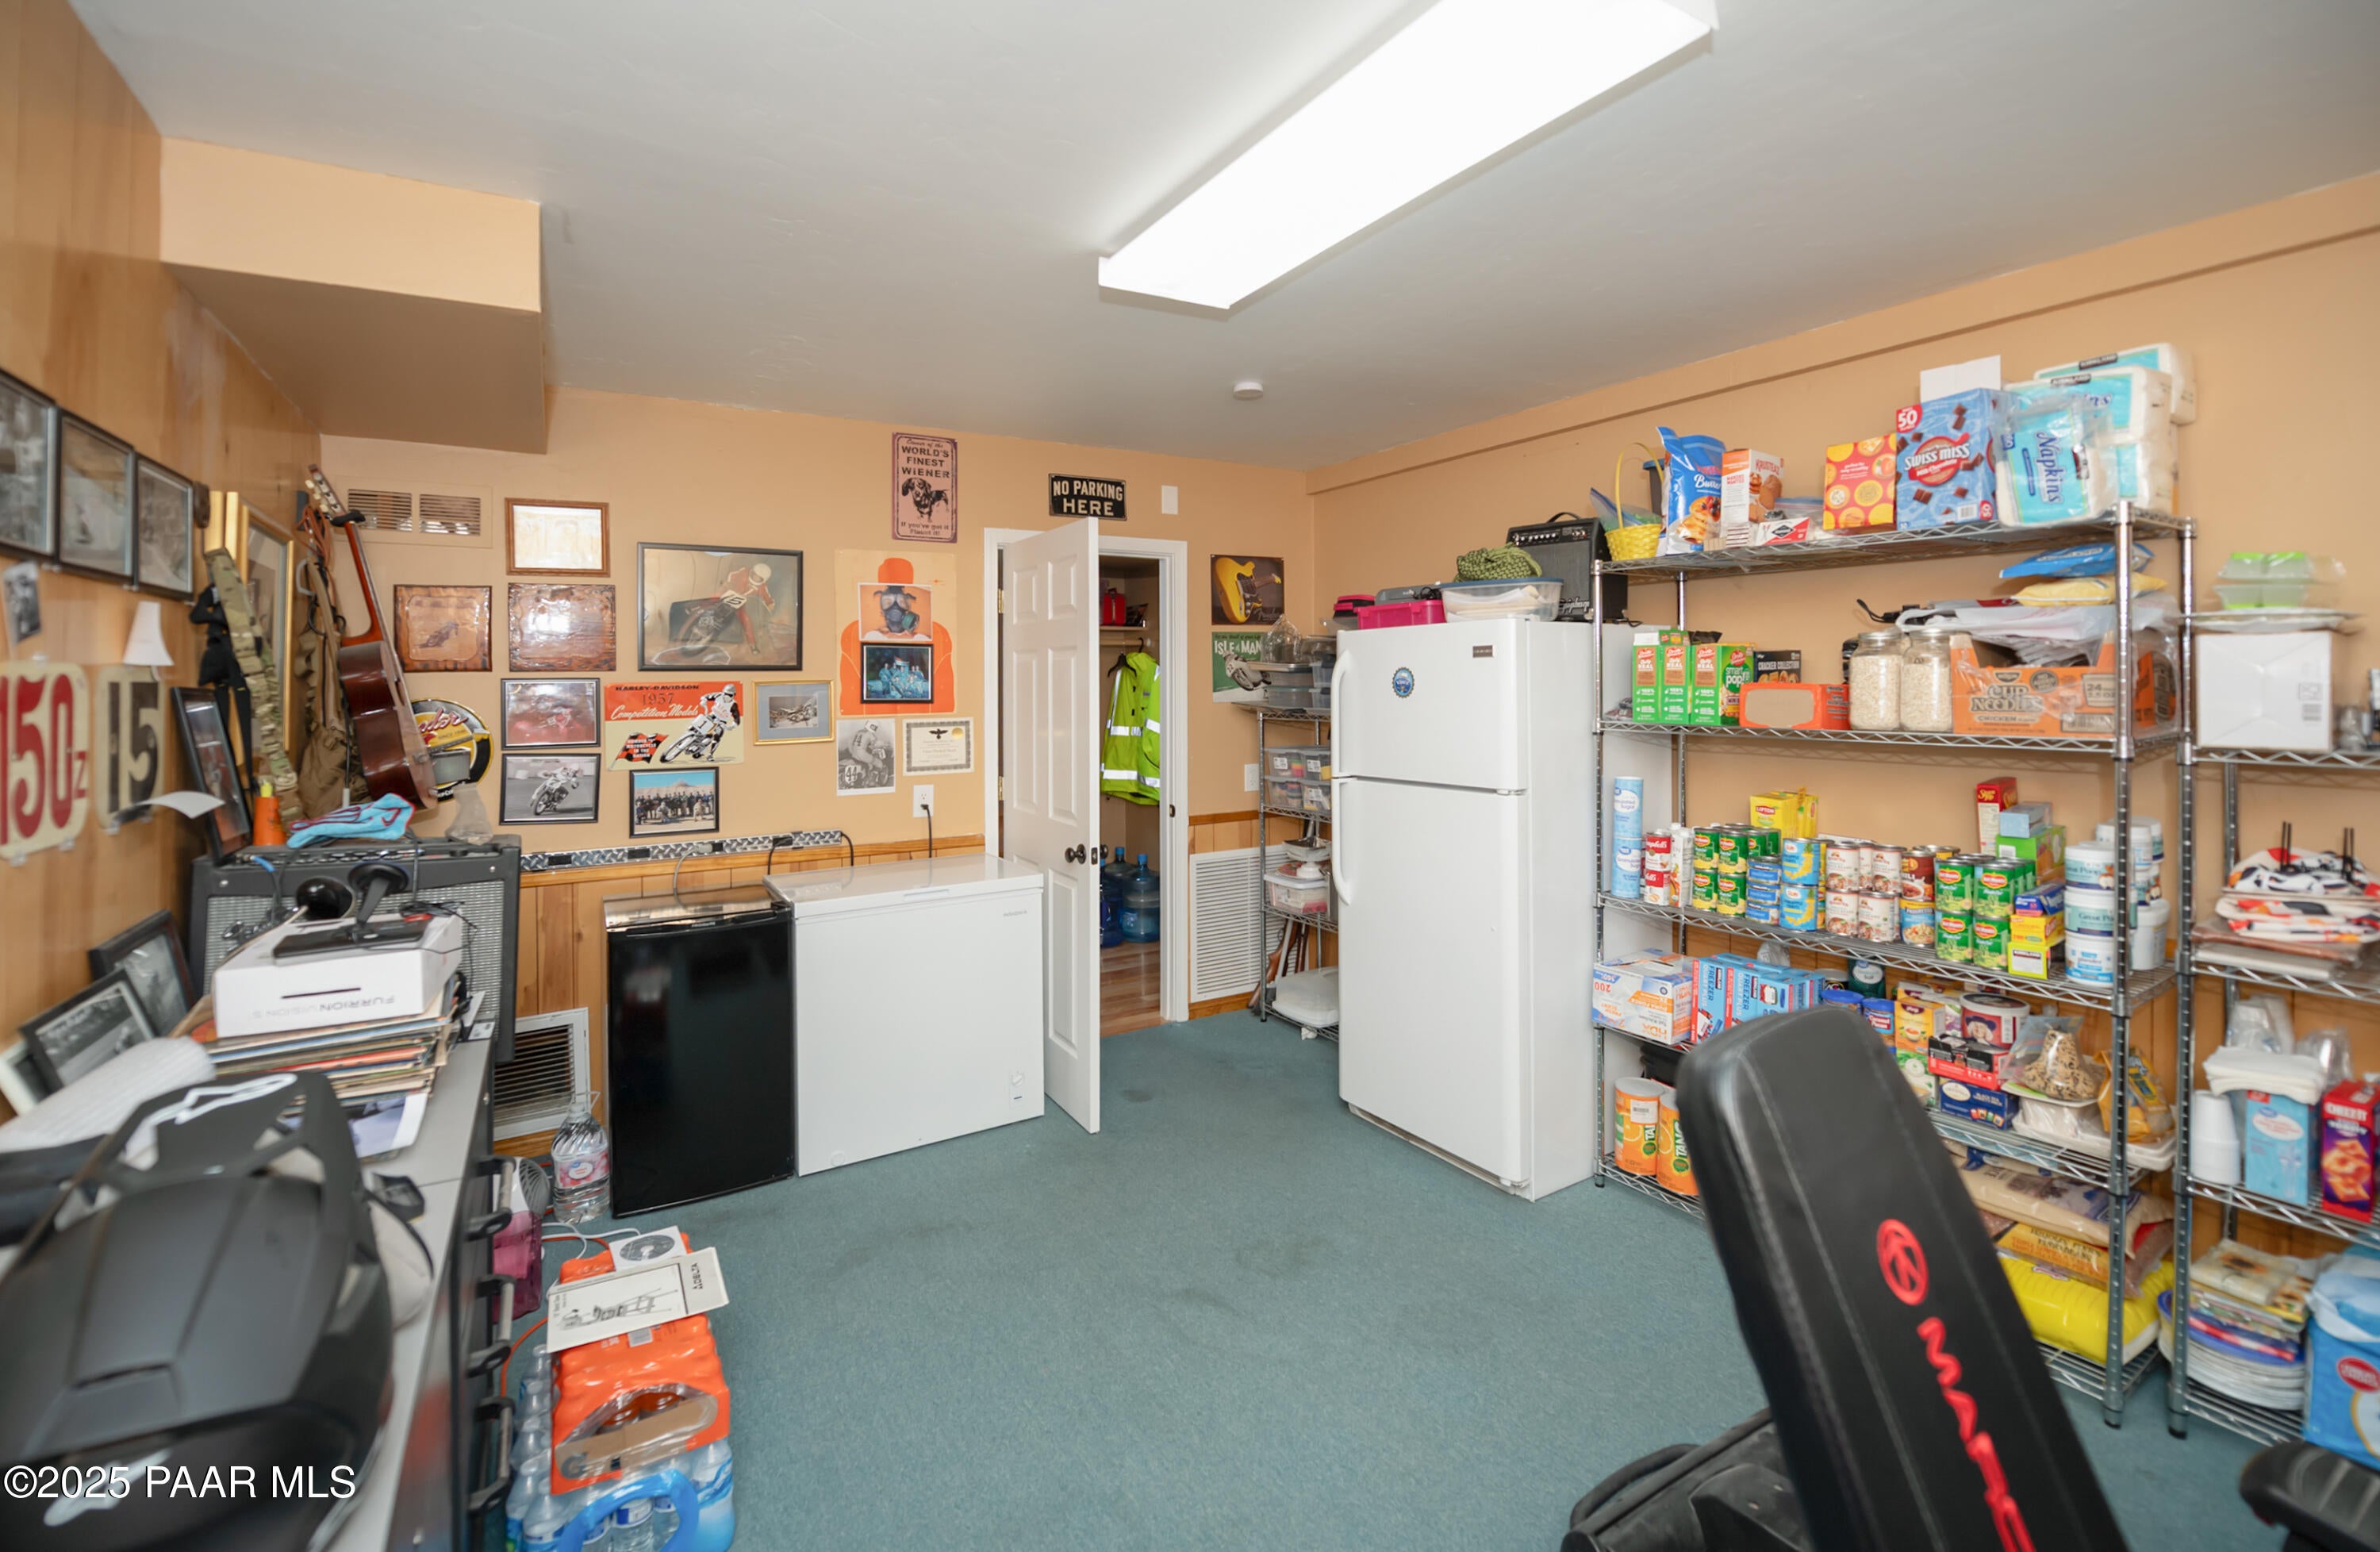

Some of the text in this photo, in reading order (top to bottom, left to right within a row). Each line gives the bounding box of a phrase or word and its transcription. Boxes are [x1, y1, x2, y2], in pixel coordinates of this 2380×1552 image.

[1898, 410, 1917, 428] 50
[901, 445, 950, 459] WORLD'S
[906, 456, 945, 468] FINEST
[1904, 451, 1937, 471] SWISS
[2036, 432, 2063, 503] Napkins
[1053, 481, 1123, 501] NO PARKING
[1063, 497, 1114, 516] HERE
[1214, 640, 1235, 655] ISLE
[1241, 640, 1261, 655] MAN
[1726, 667, 1744, 675] smart
[1987, 684, 2029, 699] CUP
[2086, 683, 2102, 692] 24
[642, 693, 674, 706] 1957
[1970, 696, 2045, 713] NOODLES
[419, 707, 468, 732] nder
[610, 704, 699, 720] Competition Models
[109, 681, 159, 817] 15
[846, 766, 858, 782] 44
[1756, 805, 1775, 814] LIPTON
[1594, 982, 1612, 993] 200
[320, 995, 395, 1012] FURRION
